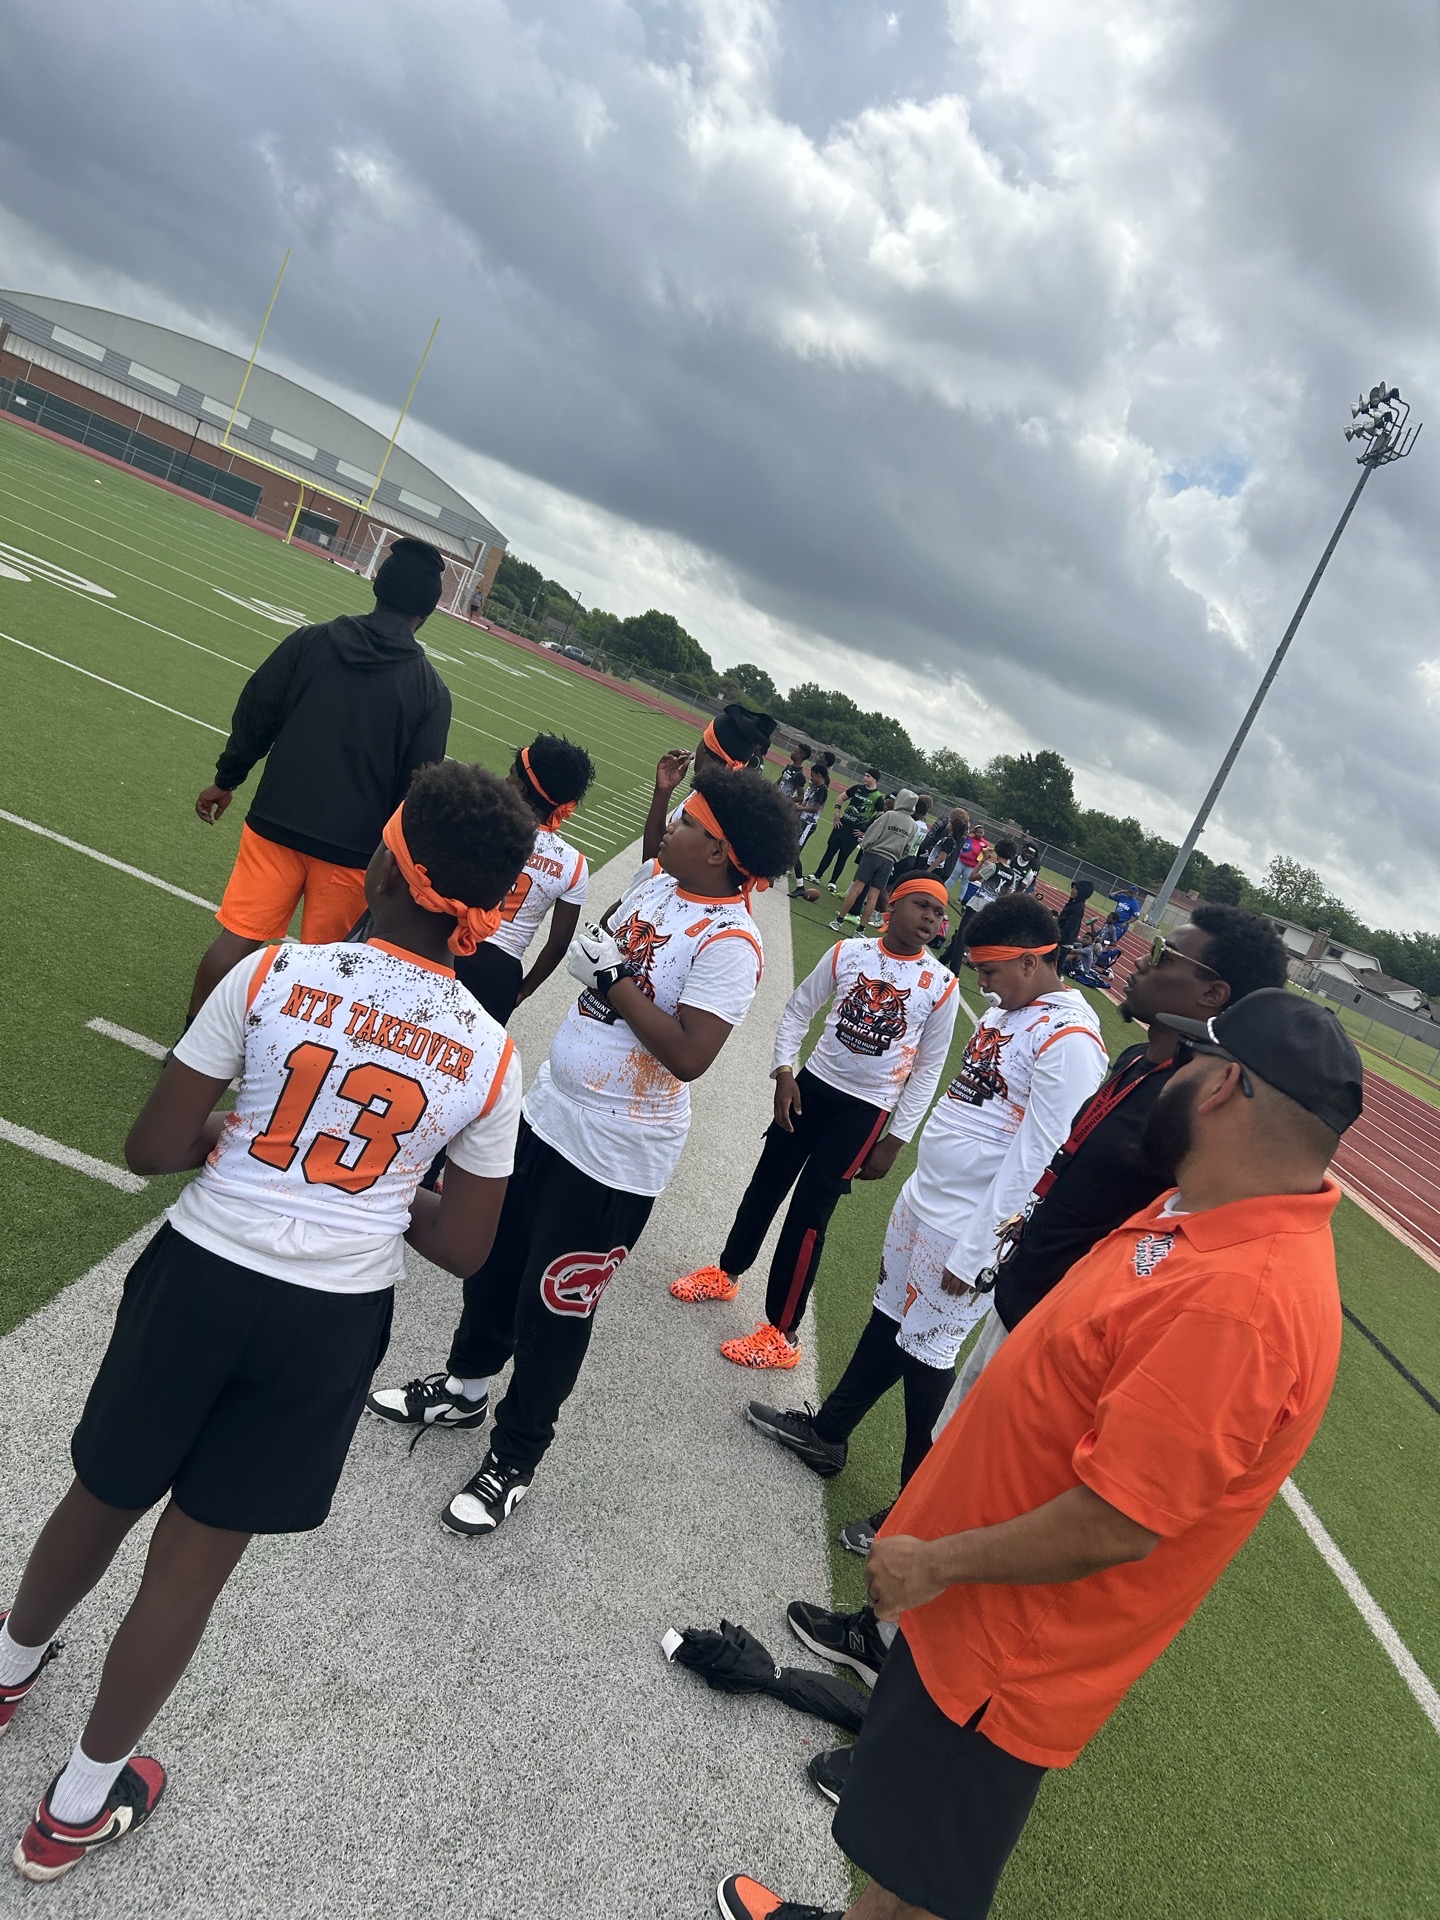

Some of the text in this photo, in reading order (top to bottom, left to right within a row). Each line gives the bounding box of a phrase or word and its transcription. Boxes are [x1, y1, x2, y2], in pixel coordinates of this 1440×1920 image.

[525, 852, 563, 878] EOVER
[917, 970, 934, 990] 5
[281, 984, 343, 1028] NTX
[593, 999, 611, 1015] HUNT
[839, 1017, 891, 1049] BENGALS
[857, 1022, 872, 1031] NTX
[345, 1002, 475, 1081] TAKEOVER
[862, 1041, 879, 1051] HUNT
[248, 1040, 429, 1195] 13
